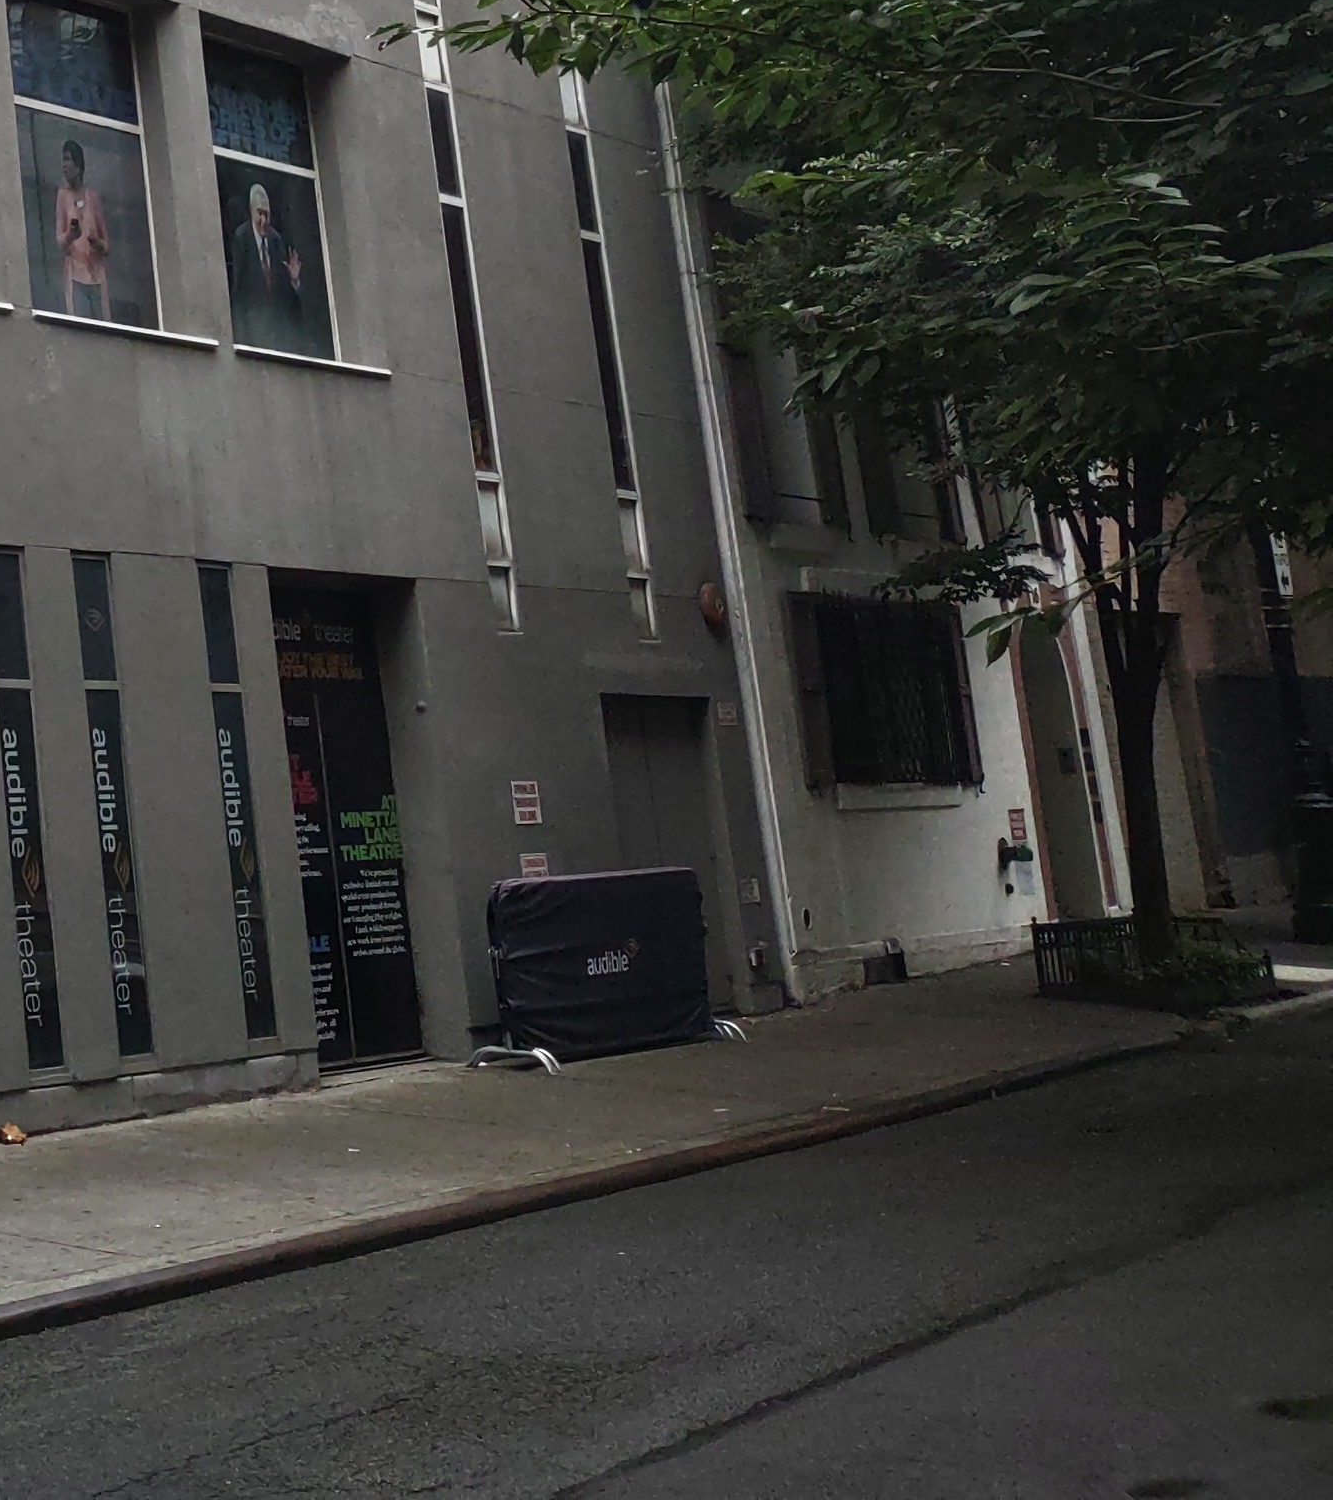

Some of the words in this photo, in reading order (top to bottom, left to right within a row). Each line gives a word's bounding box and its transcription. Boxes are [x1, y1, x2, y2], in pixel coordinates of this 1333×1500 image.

[273, 617, 302, 641] dible
[380, 794, 396, 810] AT
[340, 810, 398, 828] MINETTA
[364, 827, 400, 844] LANE
[340, 843, 403, 861] THEATRE
[92, 729, 116, 854] audible
[107, 894, 132, 1016] theater
[218, 729, 242, 848] audible
[236, 888, 258, 1002] theater
[2, 728, 26, 859] audible
[15, 901, 44, 1028] theater
[586, 951, 630, 977] audible
